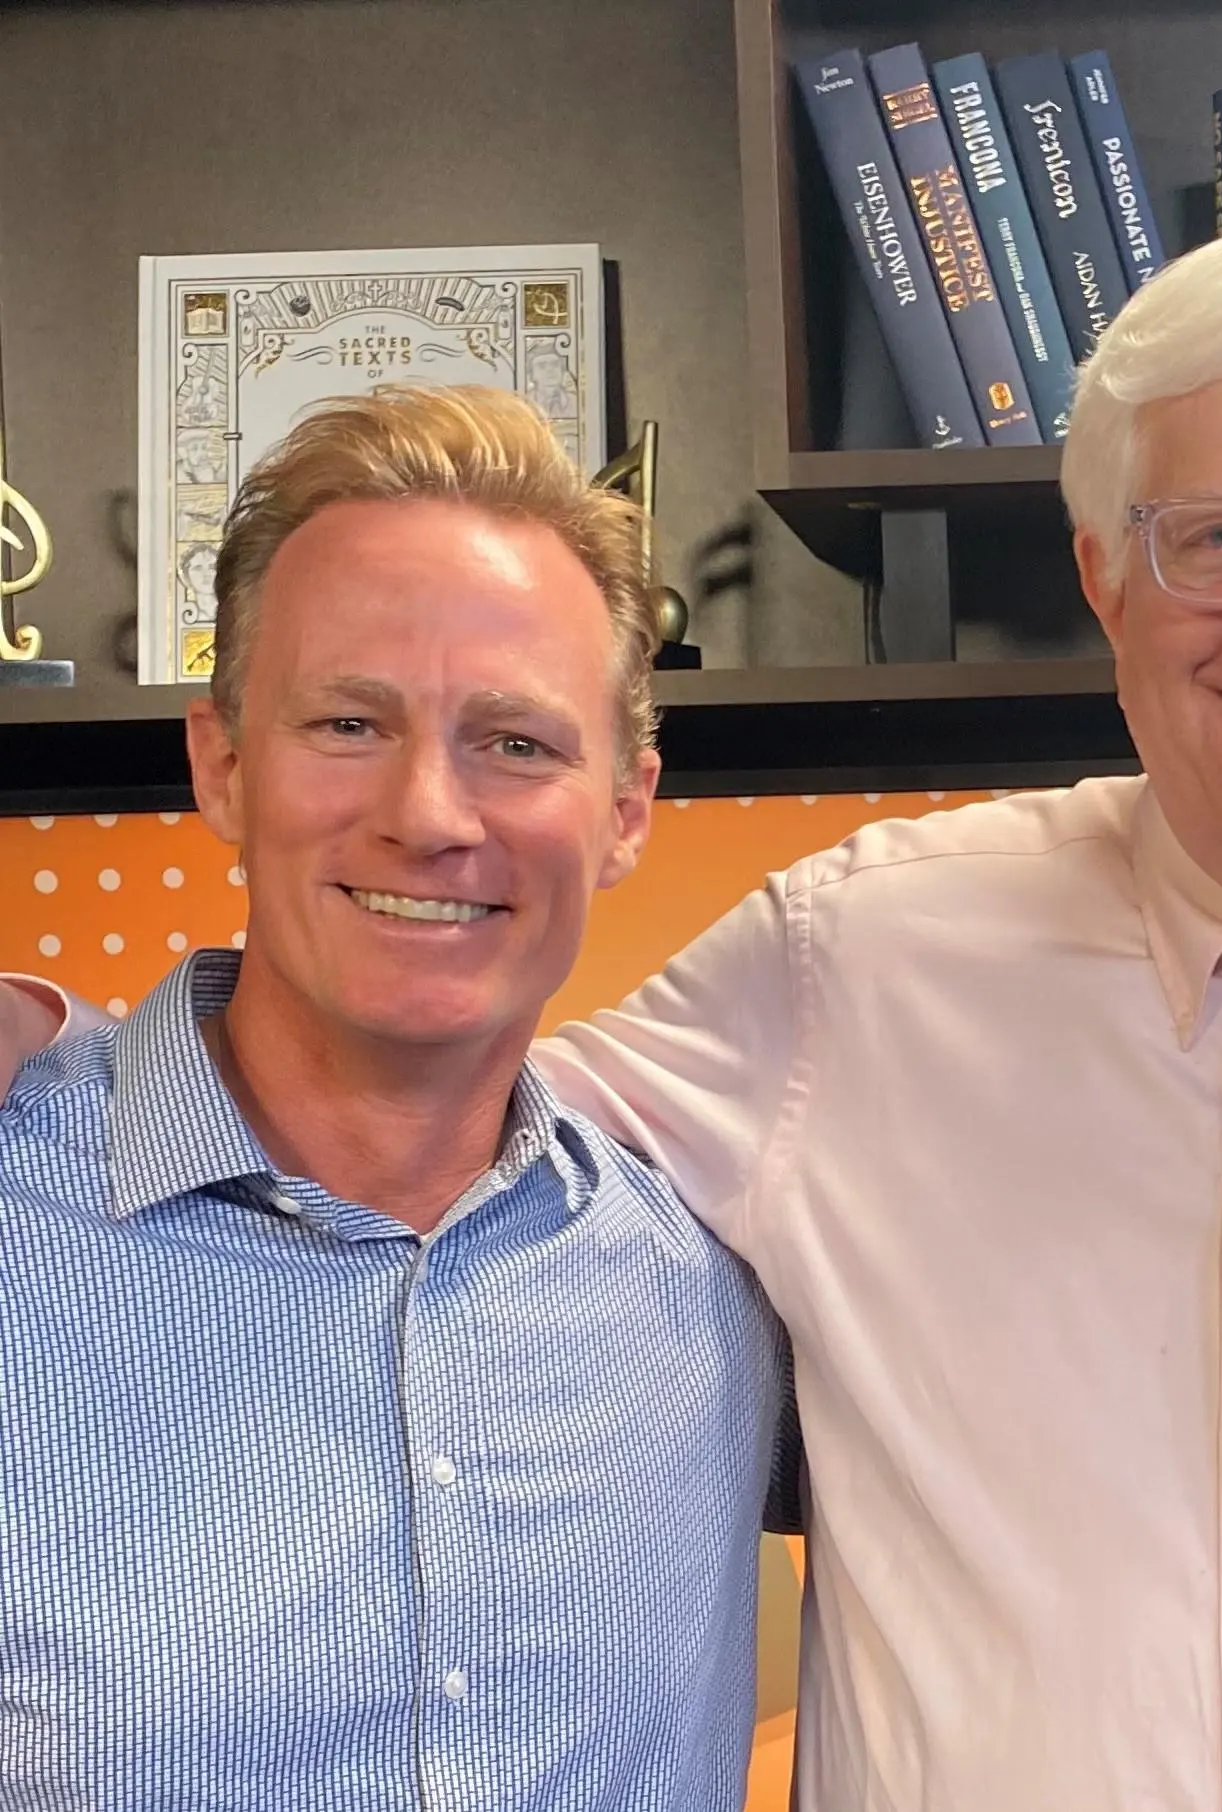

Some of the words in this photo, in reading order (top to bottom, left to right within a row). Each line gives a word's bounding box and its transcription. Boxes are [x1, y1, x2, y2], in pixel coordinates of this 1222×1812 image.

[813, 77, 855, 95] Newton
[950, 81, 1007, 193] FRANCONA
[1102, 136, 1152, 263] PASSIONATE
[856, 161, 918, 307] EISENHOWER
[909, 173, 970, 313] INJUSTICE
[935, 164, 995, 303] MANIFEST
[1072, 251, 1104, 309] AIDAN
[338, 335, 412, 350] SACRED
[338, 350, 412, 367] TEXTS
[364, 324, 387, 335] THE
[366, 368, 385, 379] OF
